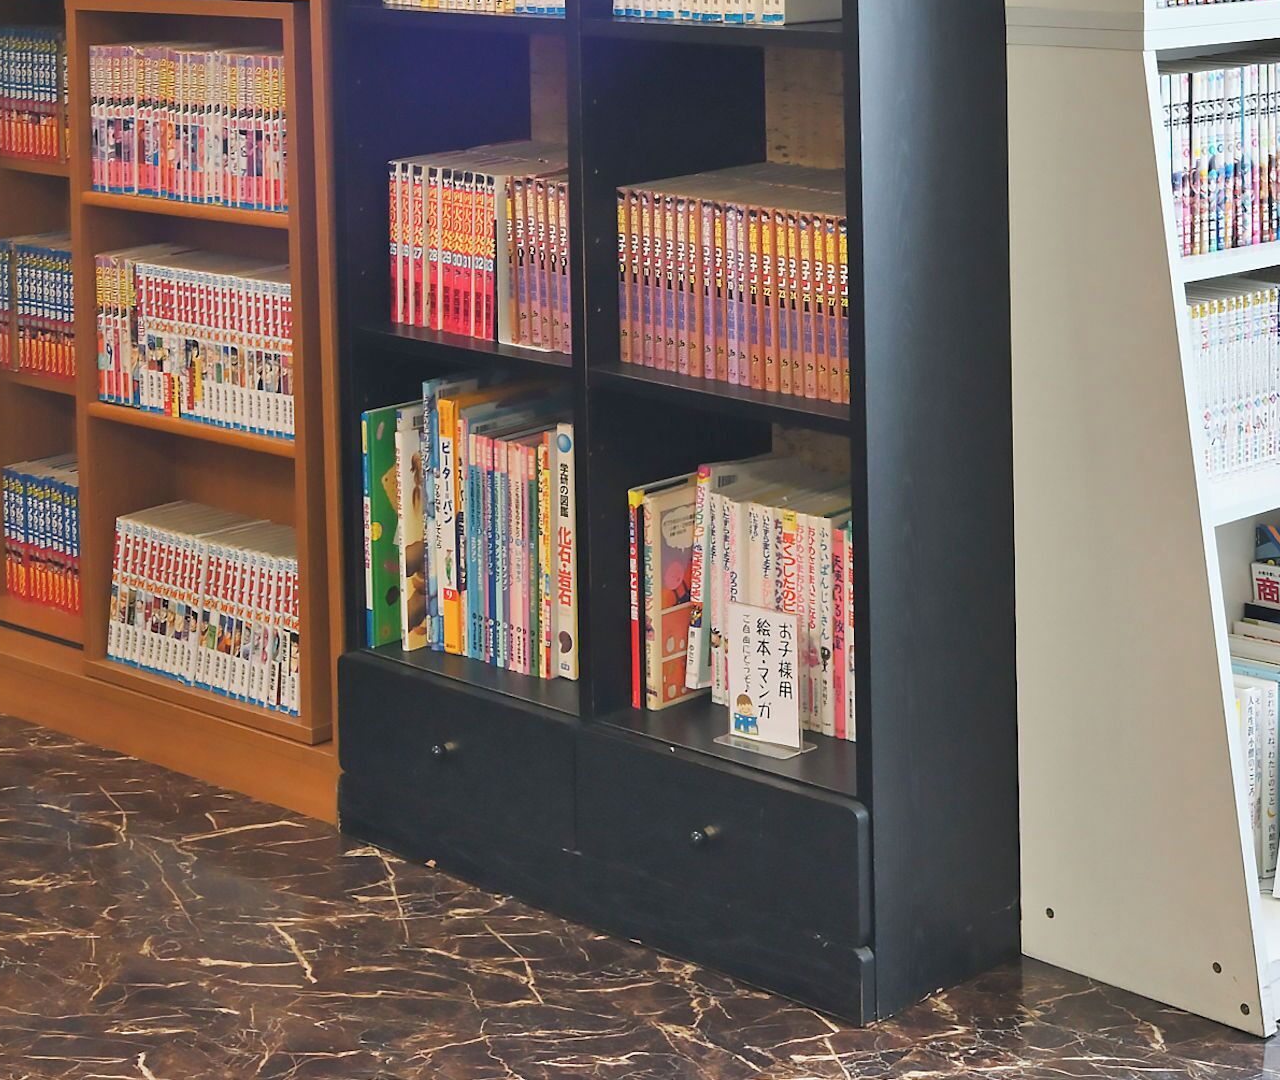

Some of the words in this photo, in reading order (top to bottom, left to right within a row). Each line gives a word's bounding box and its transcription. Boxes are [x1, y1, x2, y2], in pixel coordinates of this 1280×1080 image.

[446, 591, 452, 599] 9
[820, 528, 829, 640] ふらいぱんじいさん
[756, 618, 772, 719] 絵本・マンガ
[779, 623, 793, 699] お子様用
